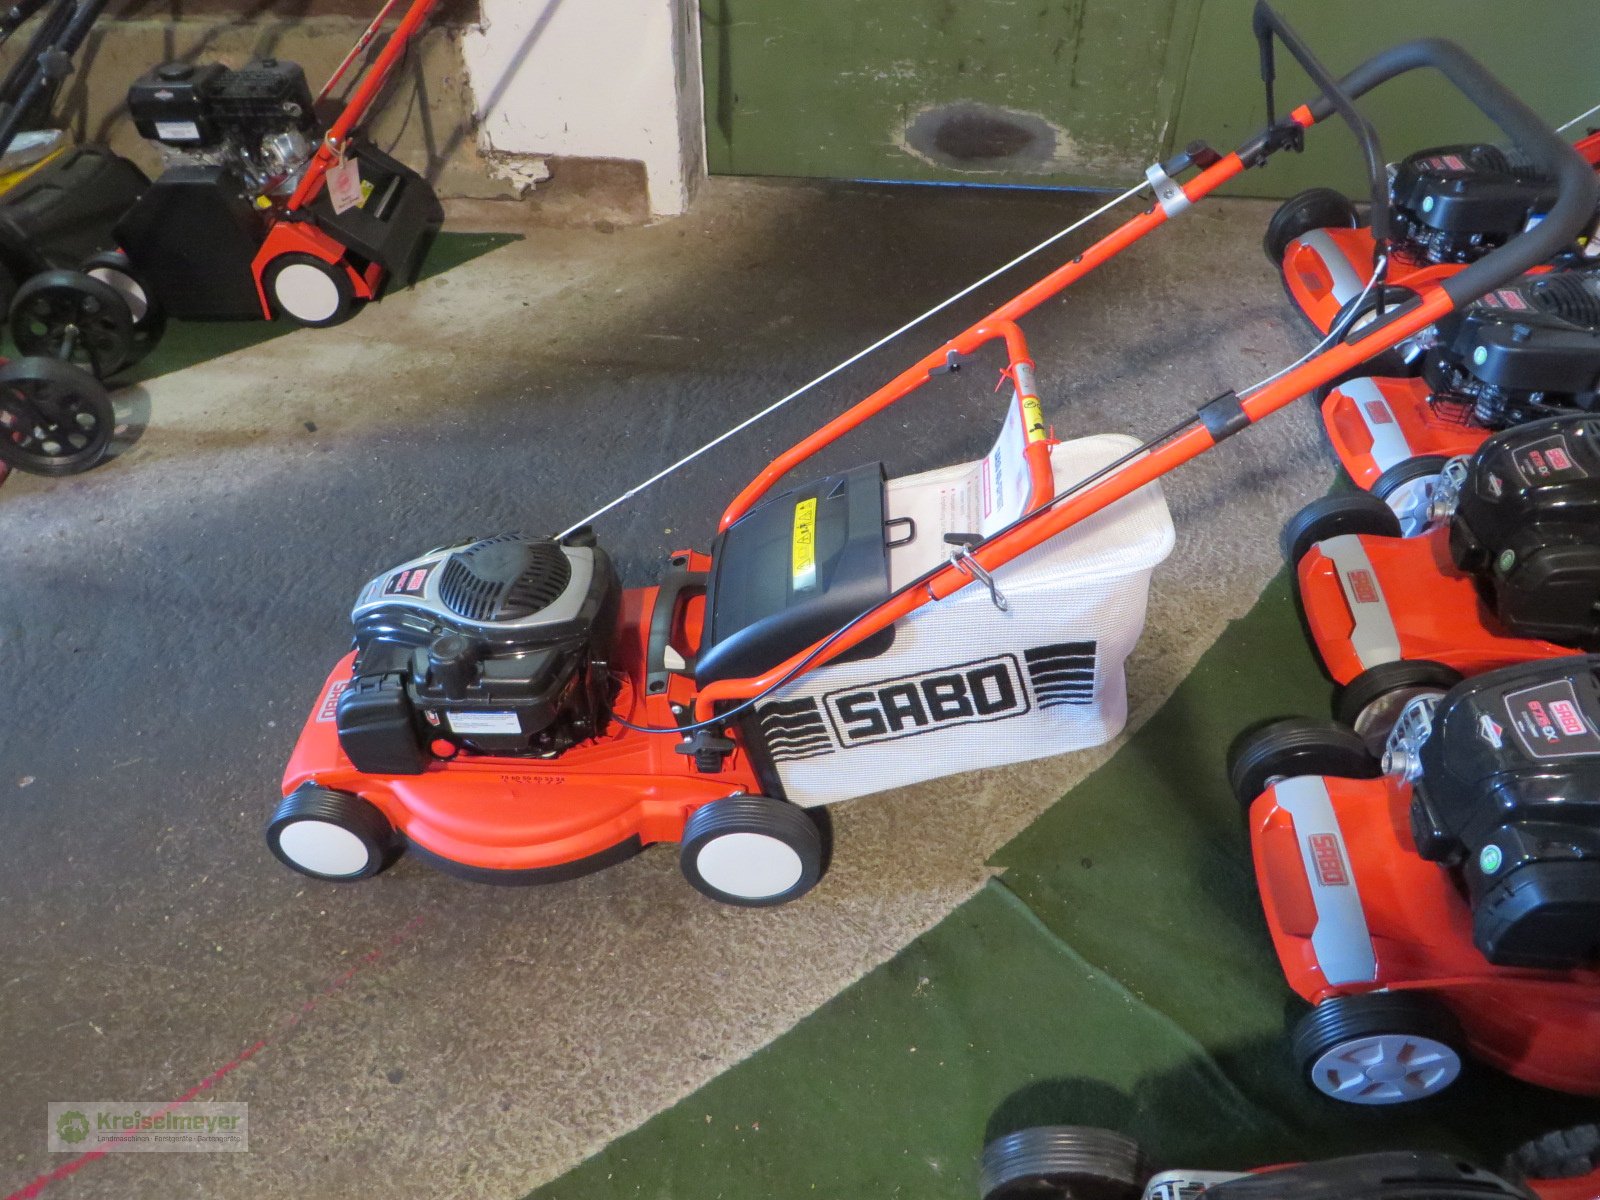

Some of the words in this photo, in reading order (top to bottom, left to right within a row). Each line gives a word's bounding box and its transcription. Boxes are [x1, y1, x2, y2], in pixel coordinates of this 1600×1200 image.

[835, 663, 1018, 740] SABO
[1553, 702, 1583, 733] SABO
[1312, 835, 1346, 883] SABO
